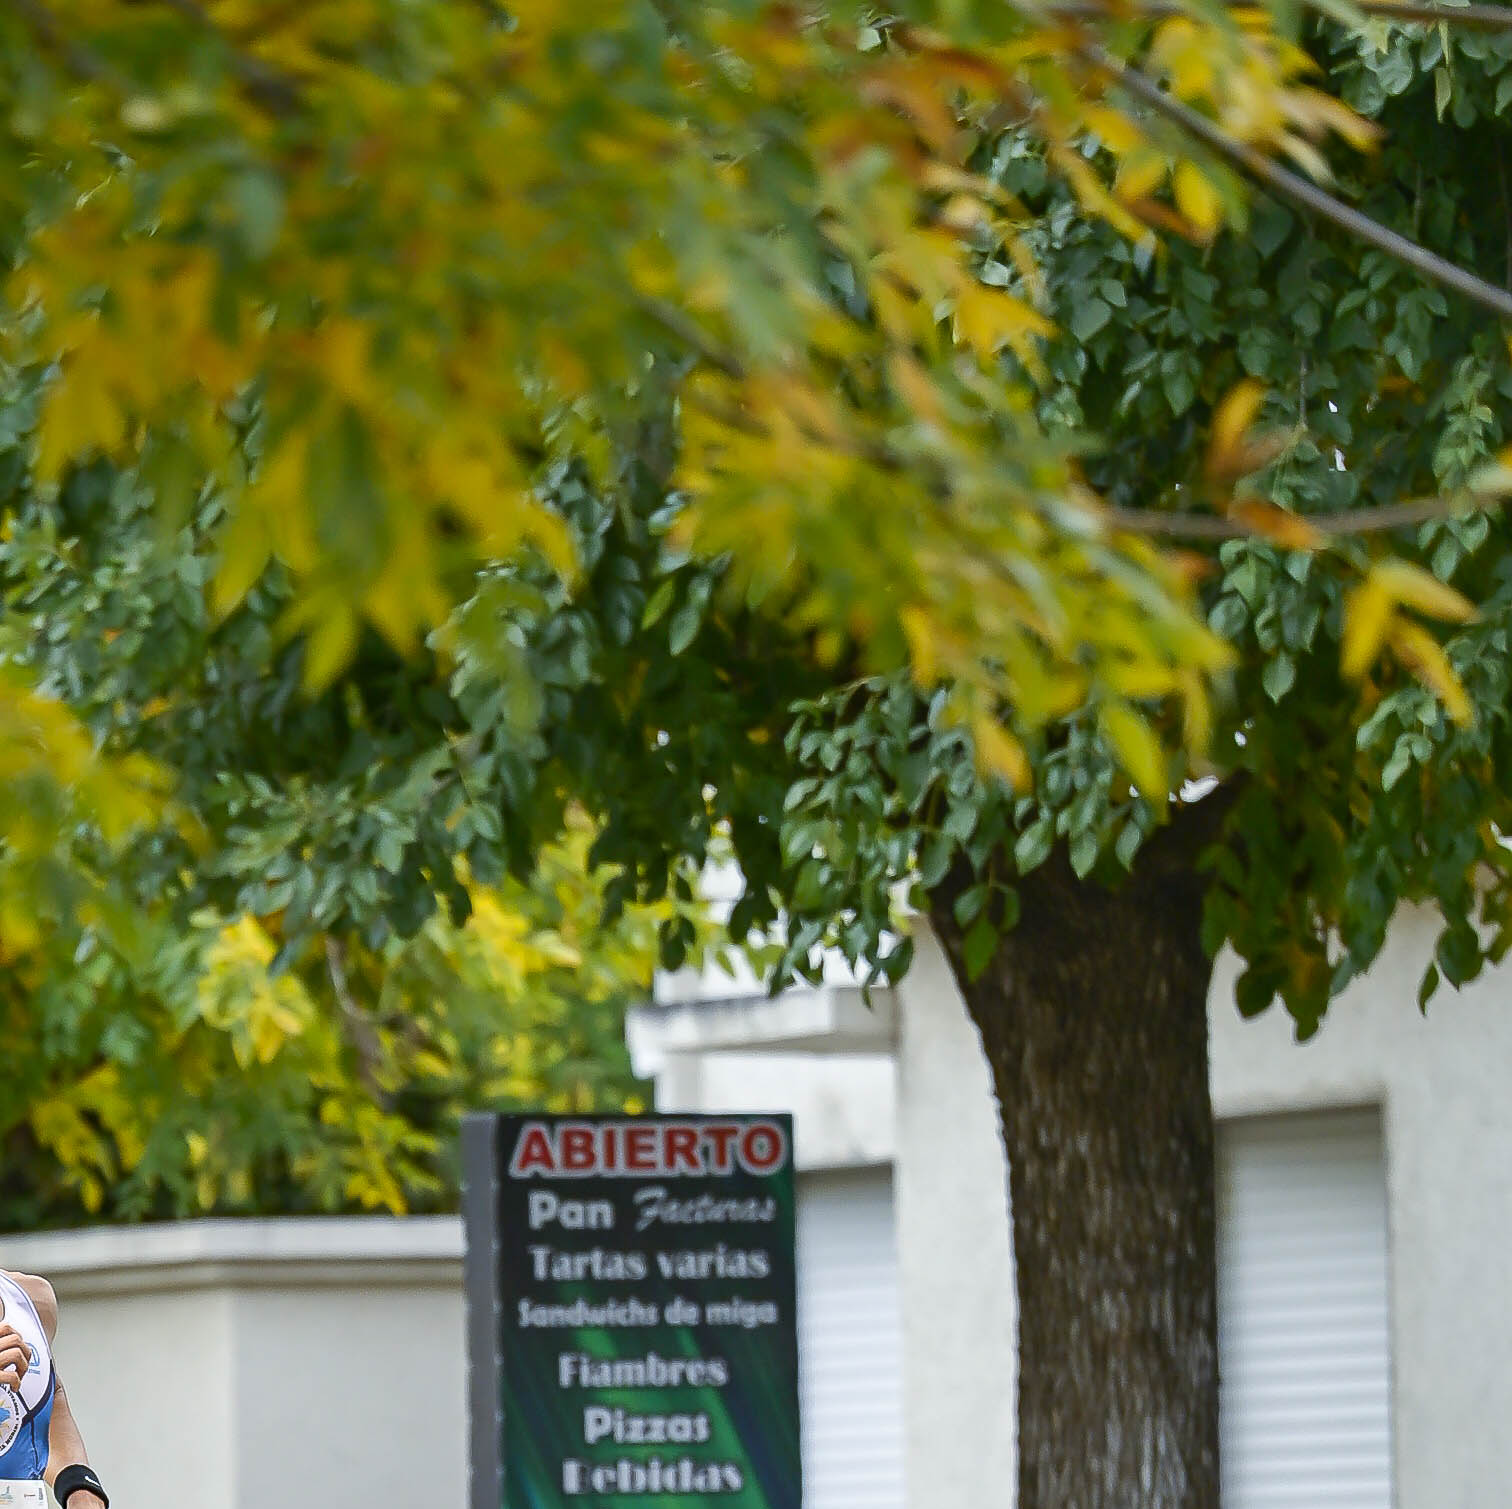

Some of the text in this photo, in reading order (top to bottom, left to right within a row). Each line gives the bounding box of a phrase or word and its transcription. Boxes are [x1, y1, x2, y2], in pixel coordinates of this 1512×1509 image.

[510, 1122, 785, 1178] ABIERTO
[528, 1190, 614, 1230] Pan
[528, 1242, 771, 1281] Tartas varias
[664, 1297, 700, 1325] de
[705, 1296, 778, 1329] miga
[558, 1352, 730, 1388] Fiambres
[584, 1406, 710, 1444] Pizzas
[562, 1458, 743, 1494] Bebidas
